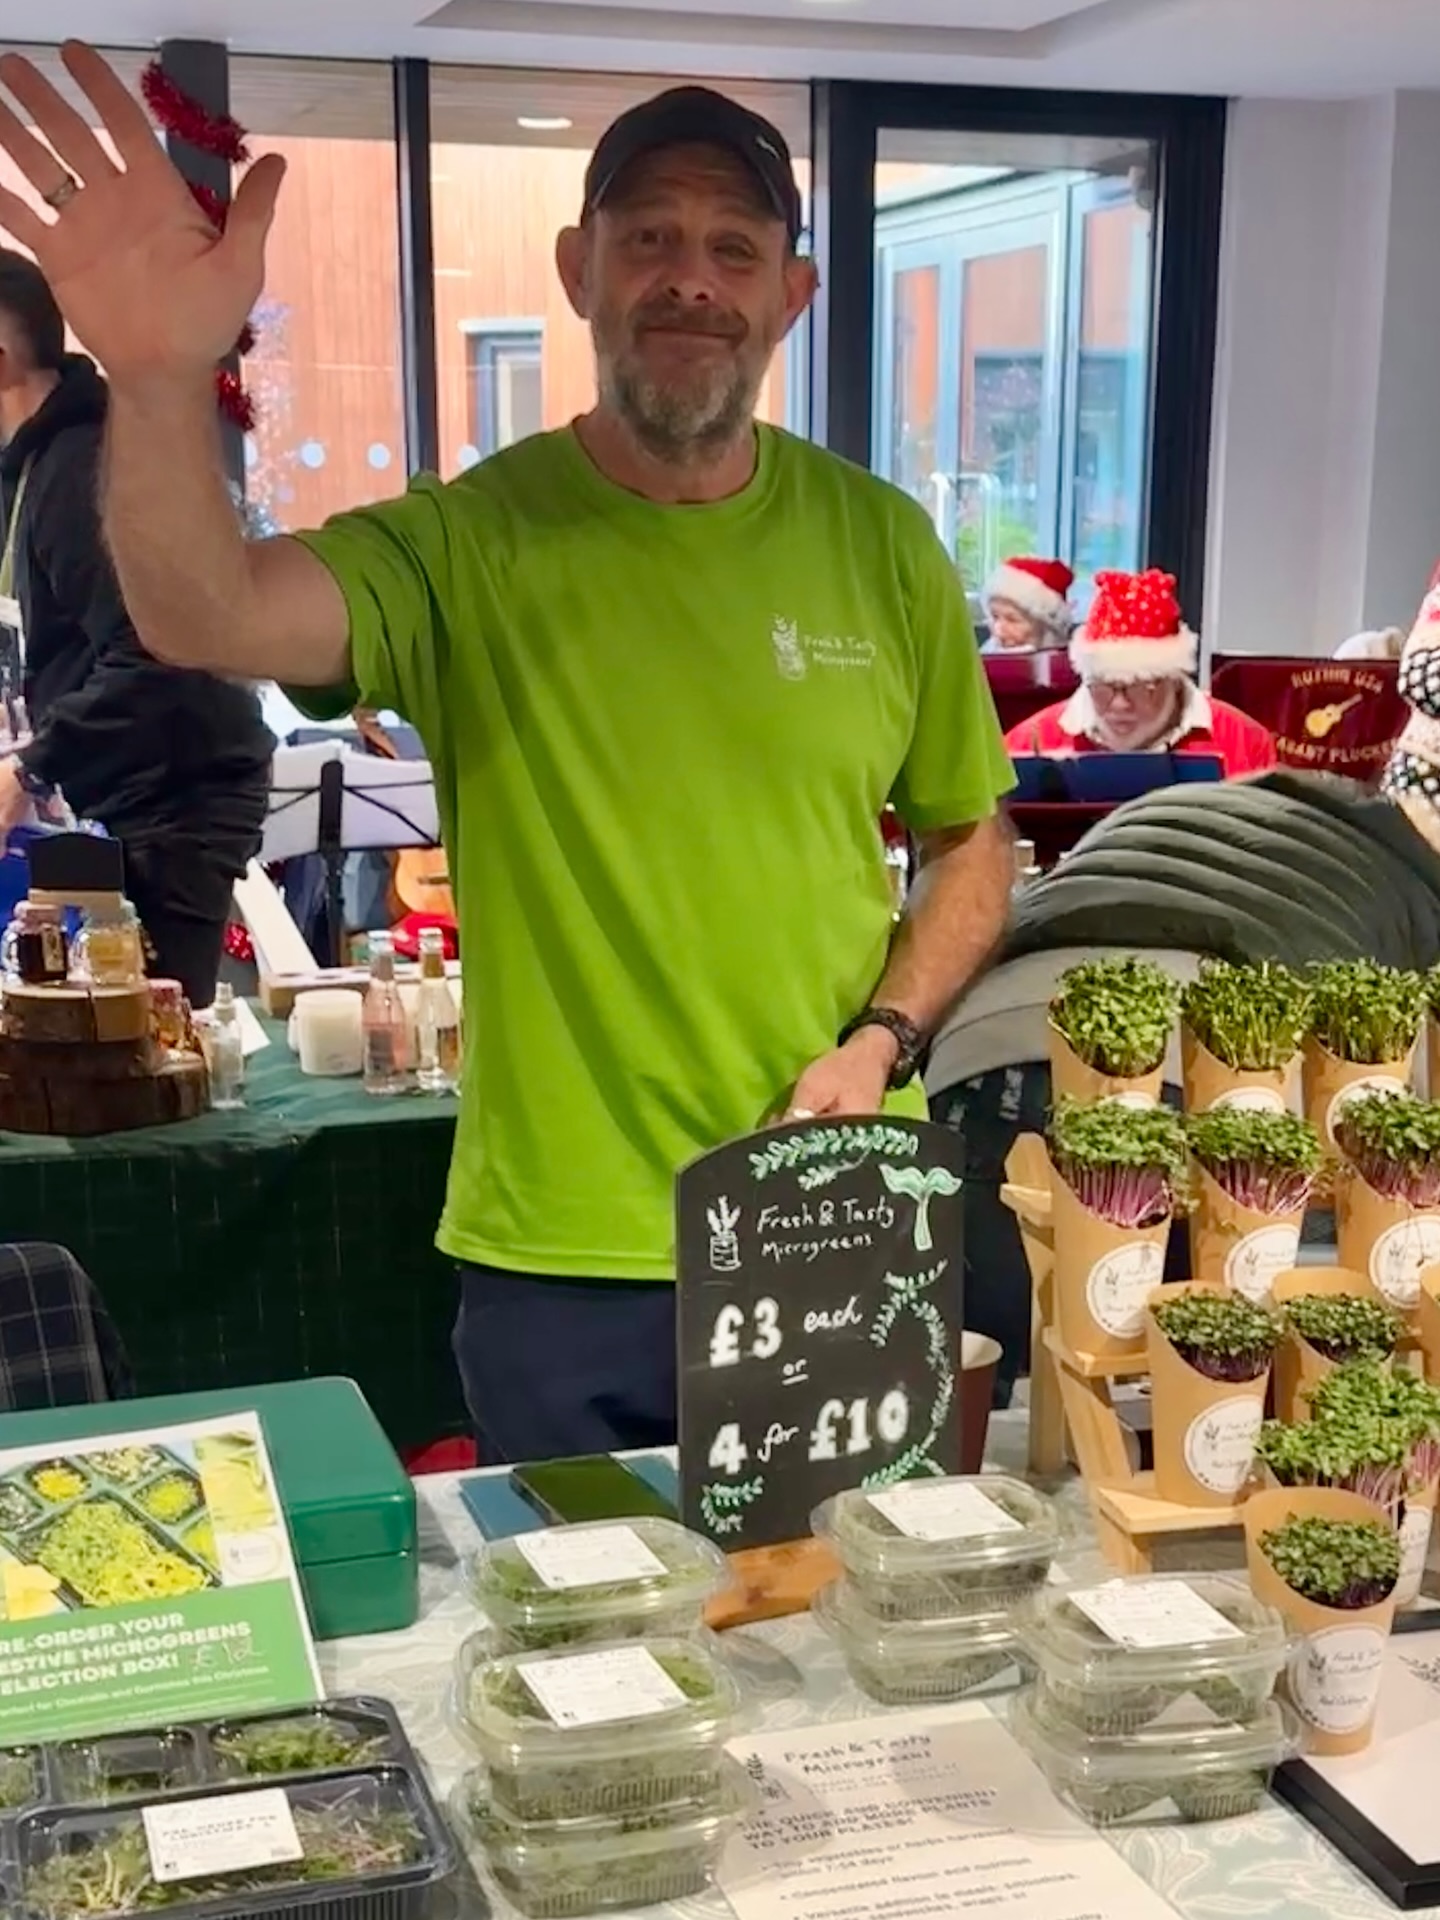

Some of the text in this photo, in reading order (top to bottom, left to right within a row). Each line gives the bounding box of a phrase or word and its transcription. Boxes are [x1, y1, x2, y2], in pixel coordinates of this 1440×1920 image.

[757, 1196, 895, 1233] Fresh & Tasty
[761, 1233, 873, 1262] Microgreens
[709, 1295, 863, 1367] £3 each
[783, 1359, 807, 1378] or
[708, 1389, 909, 1475] 4 for £10
[119, 1612, 184, 1636] YOUR
[82, 1621, 252, 1664] MICROGREENS
[123, 1652, 179, 1676] BOX!
[784, 1744, 845, 1763] Fresh
[869, 1735, 931, 1751] Tasty
[803, 1750, 932, 1774] Microgreens
[743, 1799, 992, 1841] WAY TO ADD MORE PLANTS
[779, 1808, 835, 1827] QUICK
[842, 1803, 881, 1815] AND
[884, 1788, 998, 1813] CONVENIENT
[752, 1816, 915, 1850] TO YOUR PLATES!
[861, 1855, 894, 1870] days
